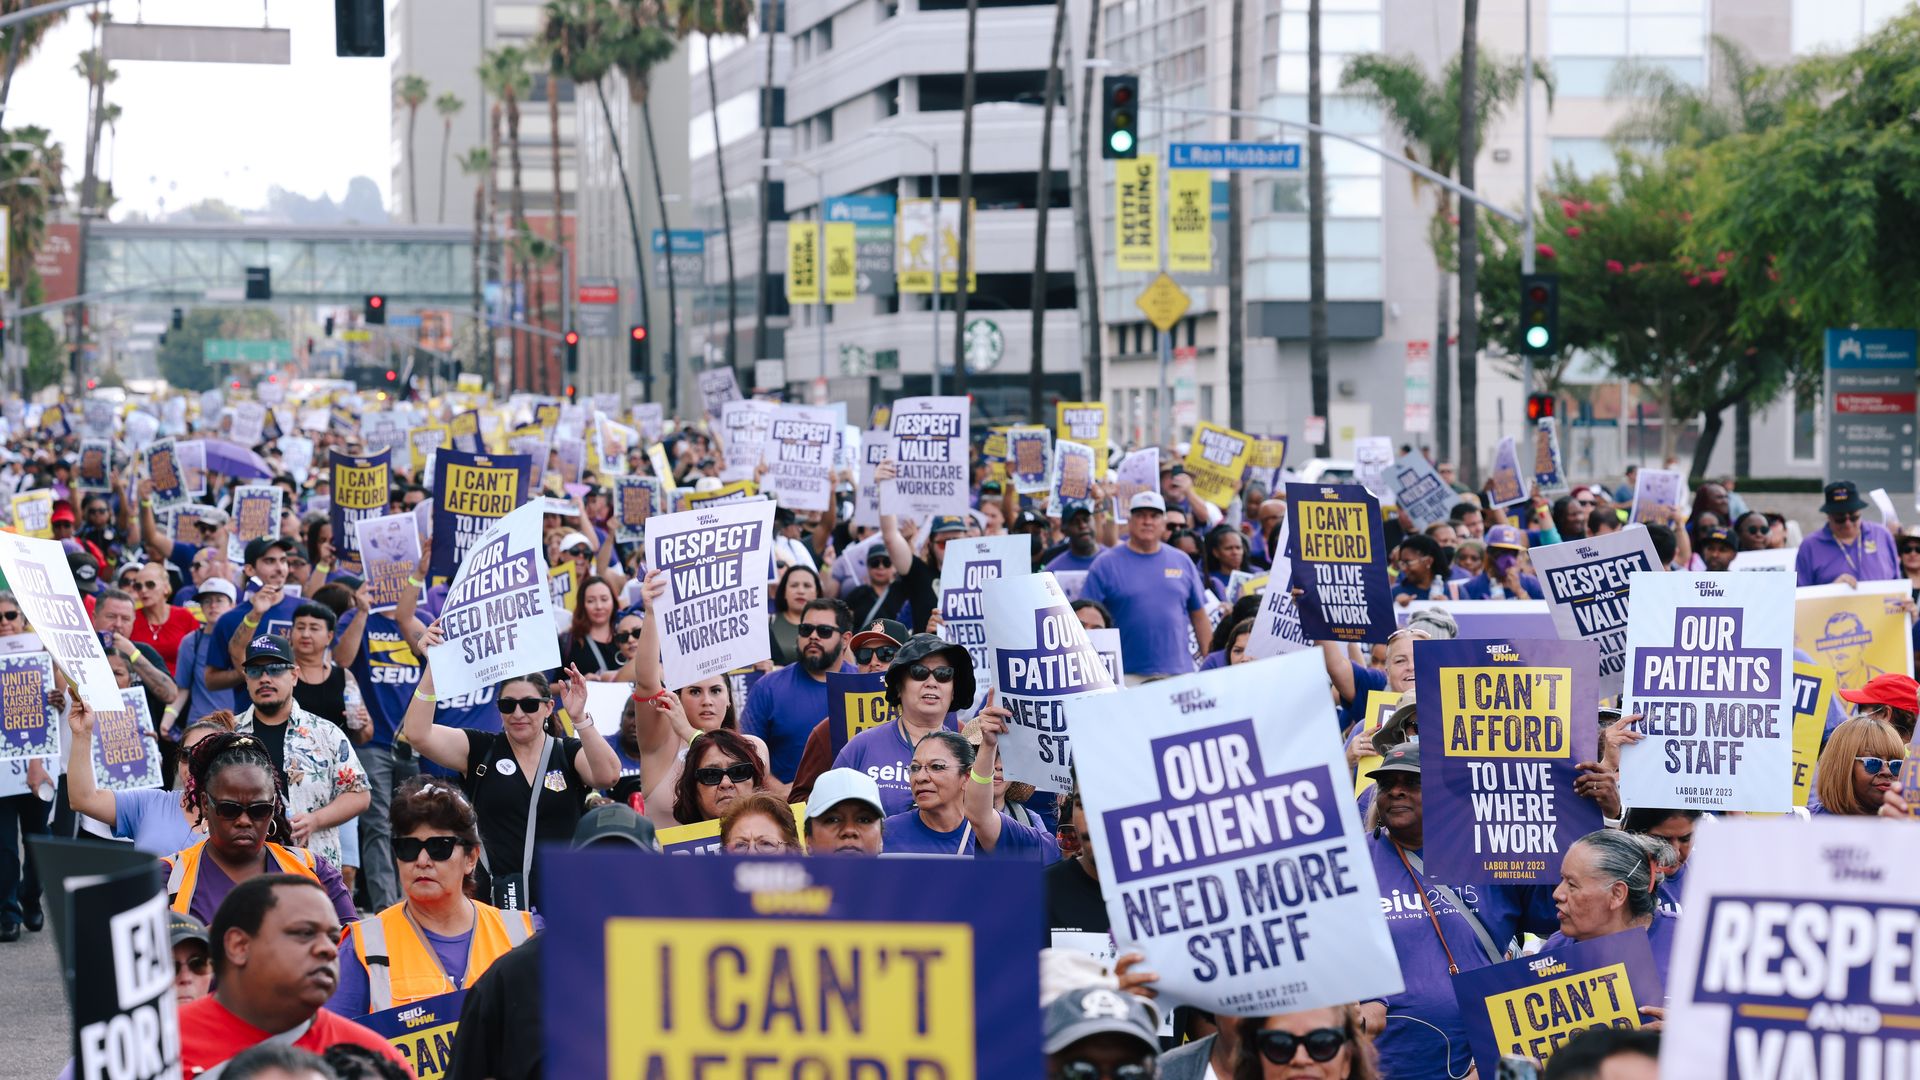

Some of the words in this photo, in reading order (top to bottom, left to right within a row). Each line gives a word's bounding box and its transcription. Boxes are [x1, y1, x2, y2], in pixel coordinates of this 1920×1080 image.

[1190, 145, 1222, 164] Ron
[1224, 145, 1296, 165] Hubbard
[1122, 184, 1136, 246] KEITH
[1137, 164, 1152, 246] HARING
[728, 411, 769, 430] RESPEC
[895, 414, 960, 436] RESPECT
[774, 421, 830, 444] RESPECT
[781, 443, 822, 464] VALUE
[900, 440, 948, 462] VALUE
[341, 469, 345, 485] I
[349, 469, 385, 487] CAN'T
[455, 469, 460, 488] I
[464, 470, 514, 492] CAN'T
[767, 462, 829, 479] HEALTHCARE
[896, 464, 963, 480] EALTHCARE
[338, 483, 386, 505] AFFORD
[775, 478, 820, 493] WORKERS
[896, 480, 955, 496] WORKERS
[448, 490, 512, 514] AFFORD
[343, 507, 359, 522] TO
[456, 515, 473, 533] TO
[474, 516, 497, 534] LIV
[1307, 506, 1312, 530] I
[1315, 506, 1362, 531] CAN'T
[660, 523, 757, 566] RESPECT
[1305, 533, 1367, 559] AFFORD
[1576, 547, 1593, 555] SEIU-
[1581, 551, 1599, 559] UHW
[371, 559, 414, 576] FLEECING
[470, 540, 505, 575] OUR
[694, 555, 717, 566] AND
[20, 565, 52, 596] OUR
[447, 557, 530, 611] PATIENTS
[674, 559, 738, 600] VALUE
[1314, 564, 1333, 584] TO
[1334, 565, 1364, 585] LIVE
[1551, 554, 1642, 599] RESPECT
[1695, 581, 1718, 589] SEIU-
[372, 578, 408, 594] FAILIN
[1316, 585, 1367, 606] WHERE
[1595, 590, 1616, 601] AND
[1699, 589, 1725, 597] UHW
[440, 606, 482, 642] NEED
[485, 588, 544, 629] MORE
[664, 586, 760, 635] HEALTHCARE
[947, 592, 983, 618] PATI
[1321, 605, 1329, 623] I
[1331, 605, 1372, 625] WORK
[1575, 596, 1629, 633] VALU
[676, 613, 750, 656] WORKERS
[945, 623, 986, 645] NEED
[1680, 615, 1736, 651] OUR
[462, 623, 520, 665] STAFF
[1486, 645, 1512, 654] SEIU-
[696, 660, 711, 671] LABOR
[710, 657, 720, 667] DAY
[1492, 653, 1520, 662] UHW
[1, 671, 42, 687] UNITED
[370, 667, 421, 684] SEIU
[474, 666, 490, 679] LABOR
[489, 664, 500, 675] DAY
[500, 660, 515, 671] 2023
[1644, 655, 1771, 692] PATIENTS
[2, 683, 42, 698] AGAINST
[1457, 673, 1466, 710] I
[1474, 673, 1563, 710] CAN'T
[3, 695, 43, 708] KAISER'S
[3, 704, 43, 716] CORPORATE
[857, 697, 865, 723] I
[4, 713, 45, 731] GREED
[100, 715, 138, 733] AGAINST
[1002, 696, 1067, 733] NEED
[1631, 701, 1697, 737] NEED
[1705, 702, 1780, 739] MORE
[101, 728, 140, 744] KAISER'S
[1451, 714, 1563, 752] AFFORD
[102, 738, 141, 751] CORPORATE
[104, 747, 145, 766] GREED
[1163, 733, 1256, 800] OUR
[1664, 739, 1744, 775] STAFF
[1050, 774, 1072, 785] LABOR
[1467, 762, 1498, 791] TO
[1502, 762, 1555, 791] LIVE
[1675, 786, 1698, 796] LABOR
[1700, 787, 1713, 796] DAY
[1715, 787, 1733, 797] 2023
[1684, 797, 1724, 805] #UNITED4ALL
[1471, 793, 1557, 822] WHERE
[1121, 780, 1325, 872] PATIENTS
[1474, 824, 1481, 854] I
[1486, 824, 1559, 854] WORK
[1484, 861, 1508, 871] LABOR
[1510, 861, 1525, 871] DAY
[1526, 861, 1546, 870] 2023
[1493, 870, 1537, 879] #UNITED4ALL
[507, 881, 516, 896] ALL
[1122, 874, 1229, 941] NEED
[1235, 846, 1358, 916] MORE
[509, 896, 517, 911] FOR
[1378, 889, 1424, 913] eiu
[1404, 912, 1422, 920] Long
[1187, 912, 1310, 983] STAFF
[1702, 900, 1920, 1006] RESPE
[1529, 956, 1558, 971] SEIU-
[1537, 963, 1566, 977] UHW
[659, 945, 674, 1031] I
[706, 944, 945, 1036] CAN'T
[1218, 991, 1253, 1007] LABOR
[1256, 987, 1277, 1000] DAY
[397, 1006, 426, 1021] SEIU-
[1505, 998, 1519, 1036] I
[1524, 972, 1619, 1032] CAN'T
[406, 1013, 435, 1028] UHW
[1806, 1002, 1883, 1034] AND
[1734, 1027, 1920, 1080] VALU
